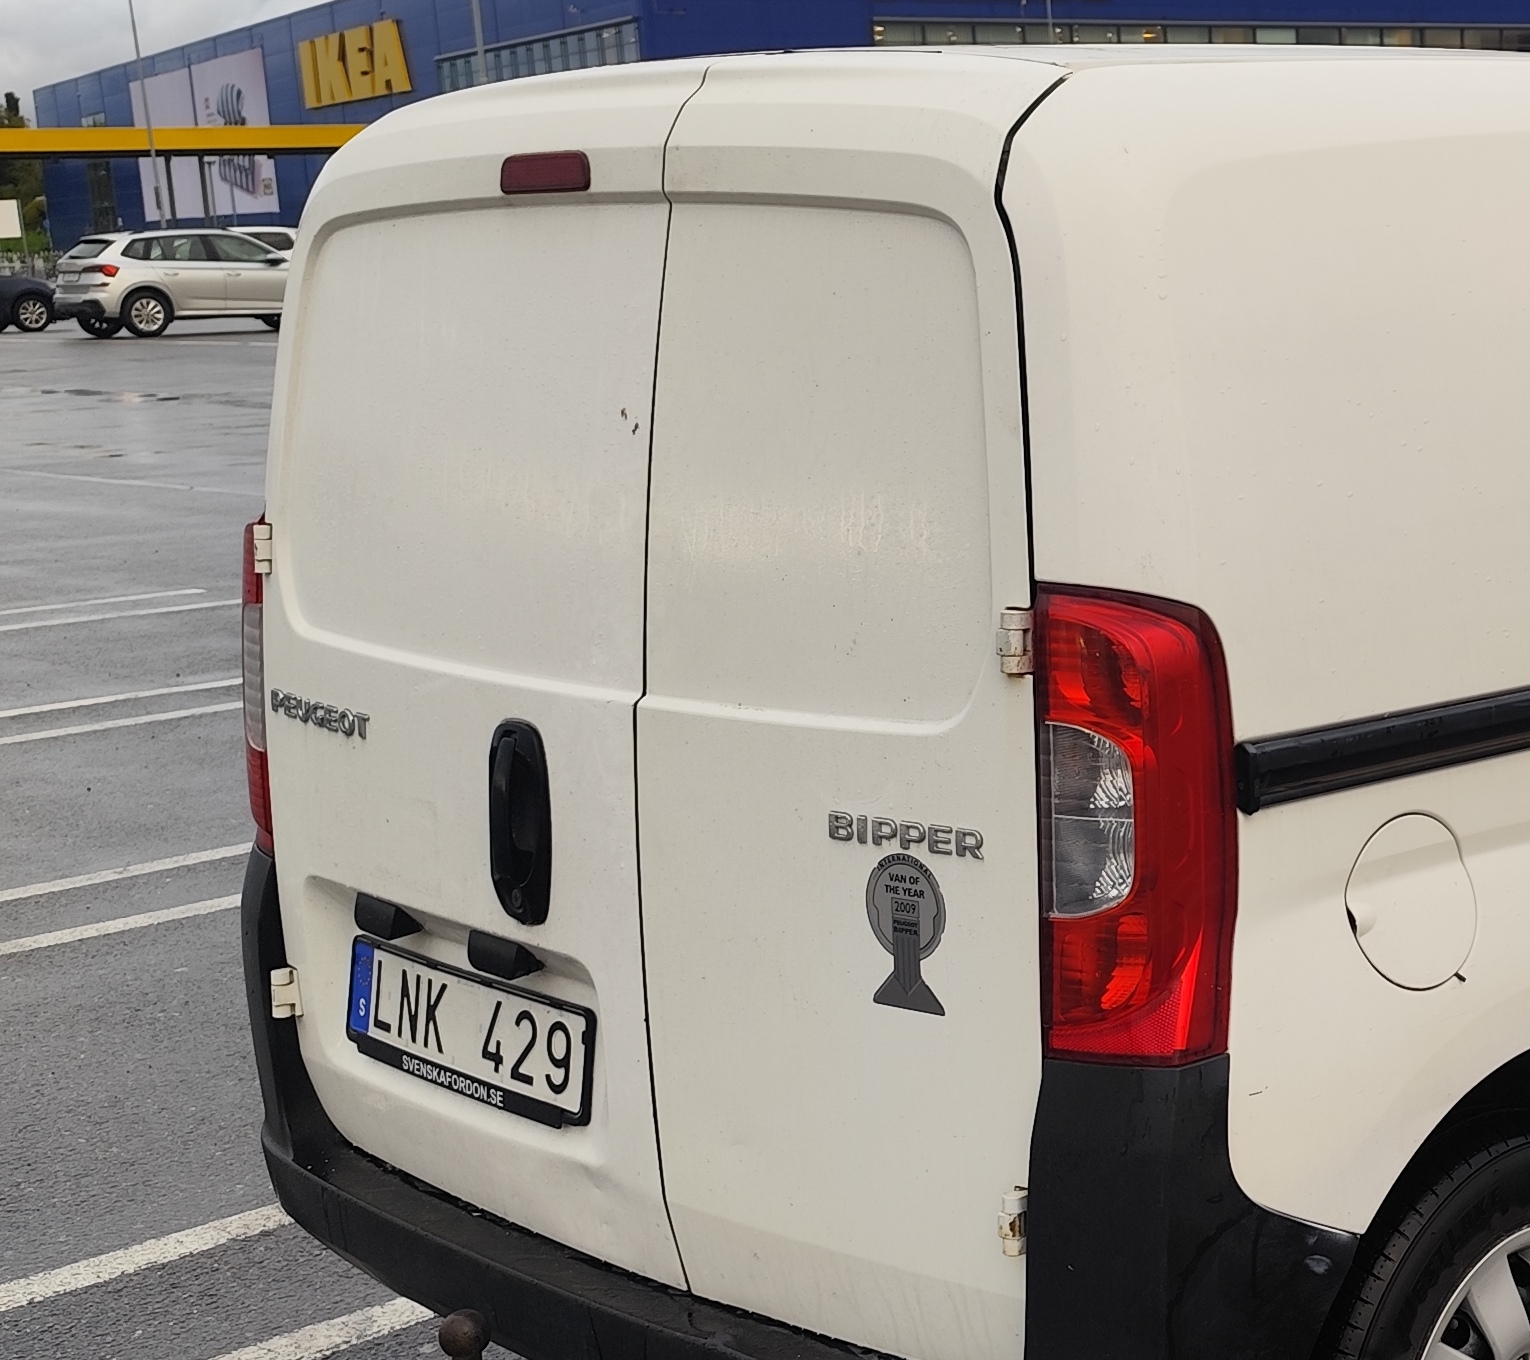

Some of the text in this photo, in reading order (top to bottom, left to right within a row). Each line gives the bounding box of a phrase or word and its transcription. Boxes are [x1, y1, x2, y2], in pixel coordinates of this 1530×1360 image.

[298, 18, 413, 110] IKEA
[271, 688, 370, 740] PEUGEOT
[828, 810, 984, 860] BIPPER
[877, 854, 932, 880] INTERNATIONAL
[889, 872, 920, 886] VAN OF
[885, 884, 925, 900] THE YEAR
[894, 901, 916, 914] 2009
[358, 997, 367, 1017] S
[373, 959, 572, 1095] LNK 429
[402, 1054, 504, 1108] SVENSKAFORDON.SE
